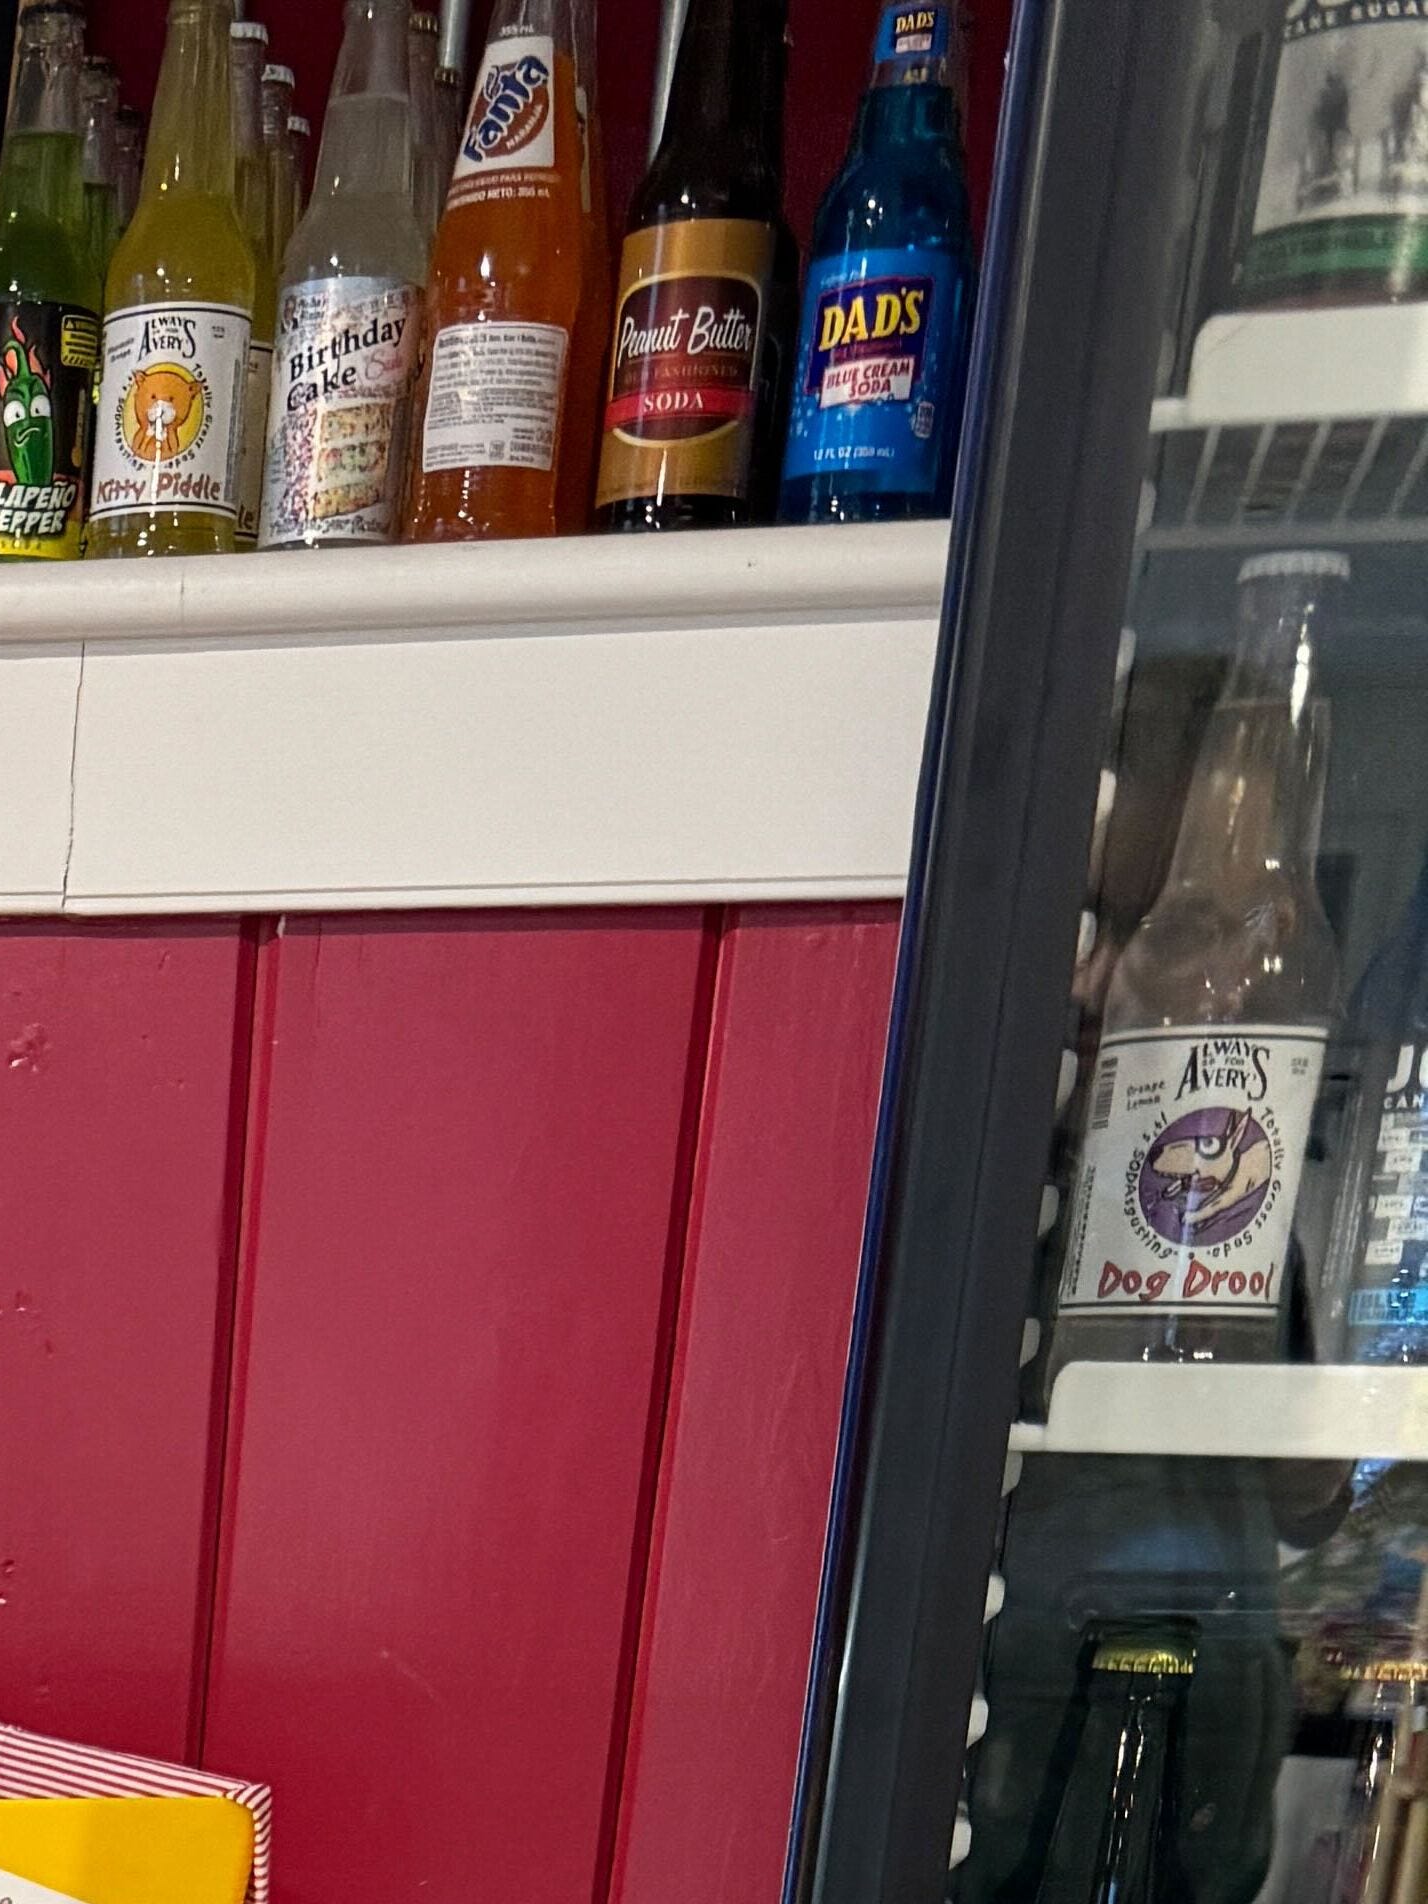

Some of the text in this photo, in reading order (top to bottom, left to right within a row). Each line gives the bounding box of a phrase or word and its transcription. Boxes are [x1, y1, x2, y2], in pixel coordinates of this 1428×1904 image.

[463, 55, 550, 163] Fanta
[618, 306, 752, 368] Peanut Butter
[818, 287, 925, 352] DAD'S
[290, 317, 406, 382] Birthday
[287, 366, 357, 411] Cake
[826, 360, 910, 390] BLUE CREAM
[849, 379, 892, 398] SODA
[644, 391, 704, 412] SODA
[98, 473, 221, 503] Kitty Piddle
[1259, 1106, 1285, 1172] Totally
[1254, 1179, 1282, 1230] Gross
[1097, 1259, 1275, 1301] Dog Drool
